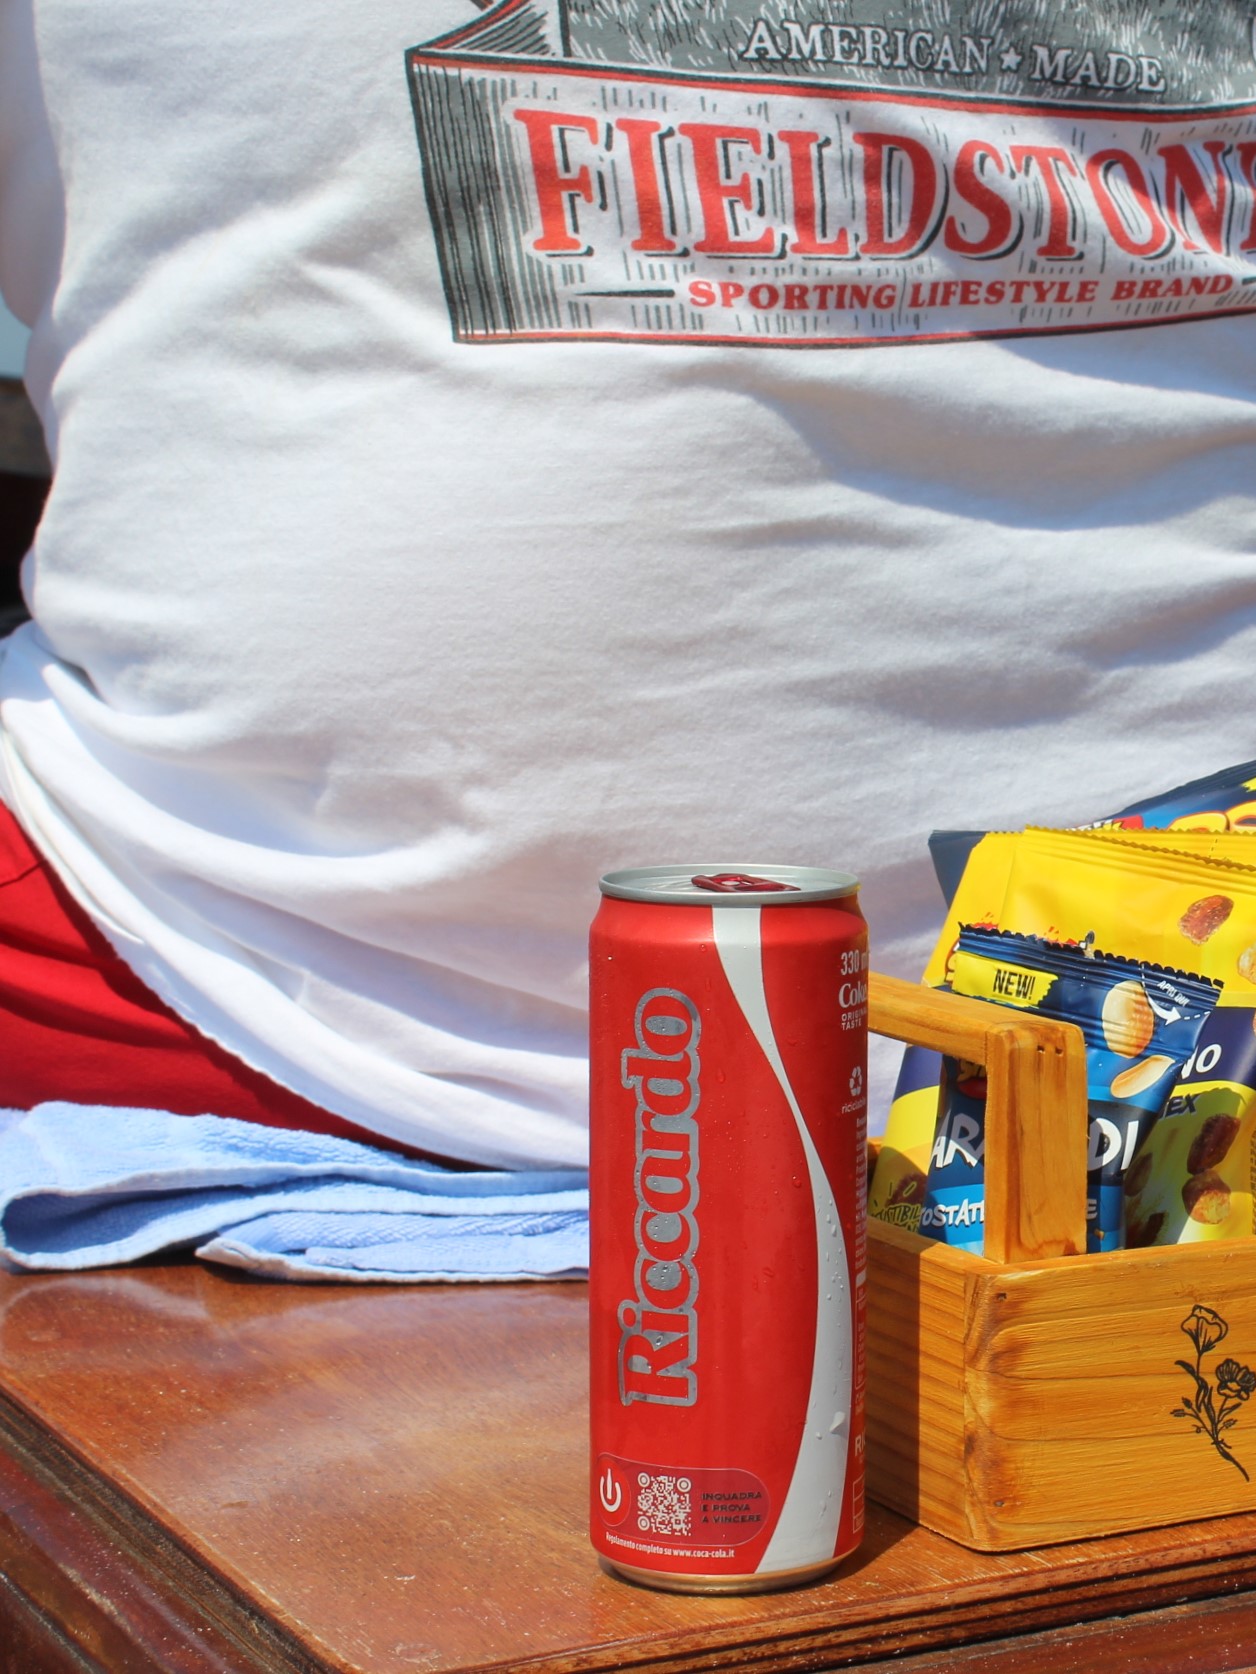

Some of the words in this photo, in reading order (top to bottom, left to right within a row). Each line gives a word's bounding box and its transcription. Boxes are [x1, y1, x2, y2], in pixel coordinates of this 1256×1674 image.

[742, 19, 995, 75] AMERICAN
[1030, 43, 1167, 92] MADE
[688, 278, 897, 311] SPORTING
[907, 279, 1100, 309] LIFESTYLE
[1111, 274, 1235, 302] BRAND
[840, 949, 860, 976] 330
[992, 968, 1037, 1000] NEW!
[1156, 980, 1178, 998] APRI
[841, 1017, 862, 1031] TASTE
[617, 987, 702, 1407] Riccardo
[702, 1491, 762, 1501] INQUADRA
[702, 1504, 708, 1512] E
[712, 1503, 751, 1512] PROVA
[702, 1515, 709, 1523] A
[713, 1514, 762, 1524] VINCERE
[606, 1531, 636, 1550] Regolamento
[635, 1541, 664, 1556] completo
[673, 1548, 735, 1558] www.coca-cola.it
